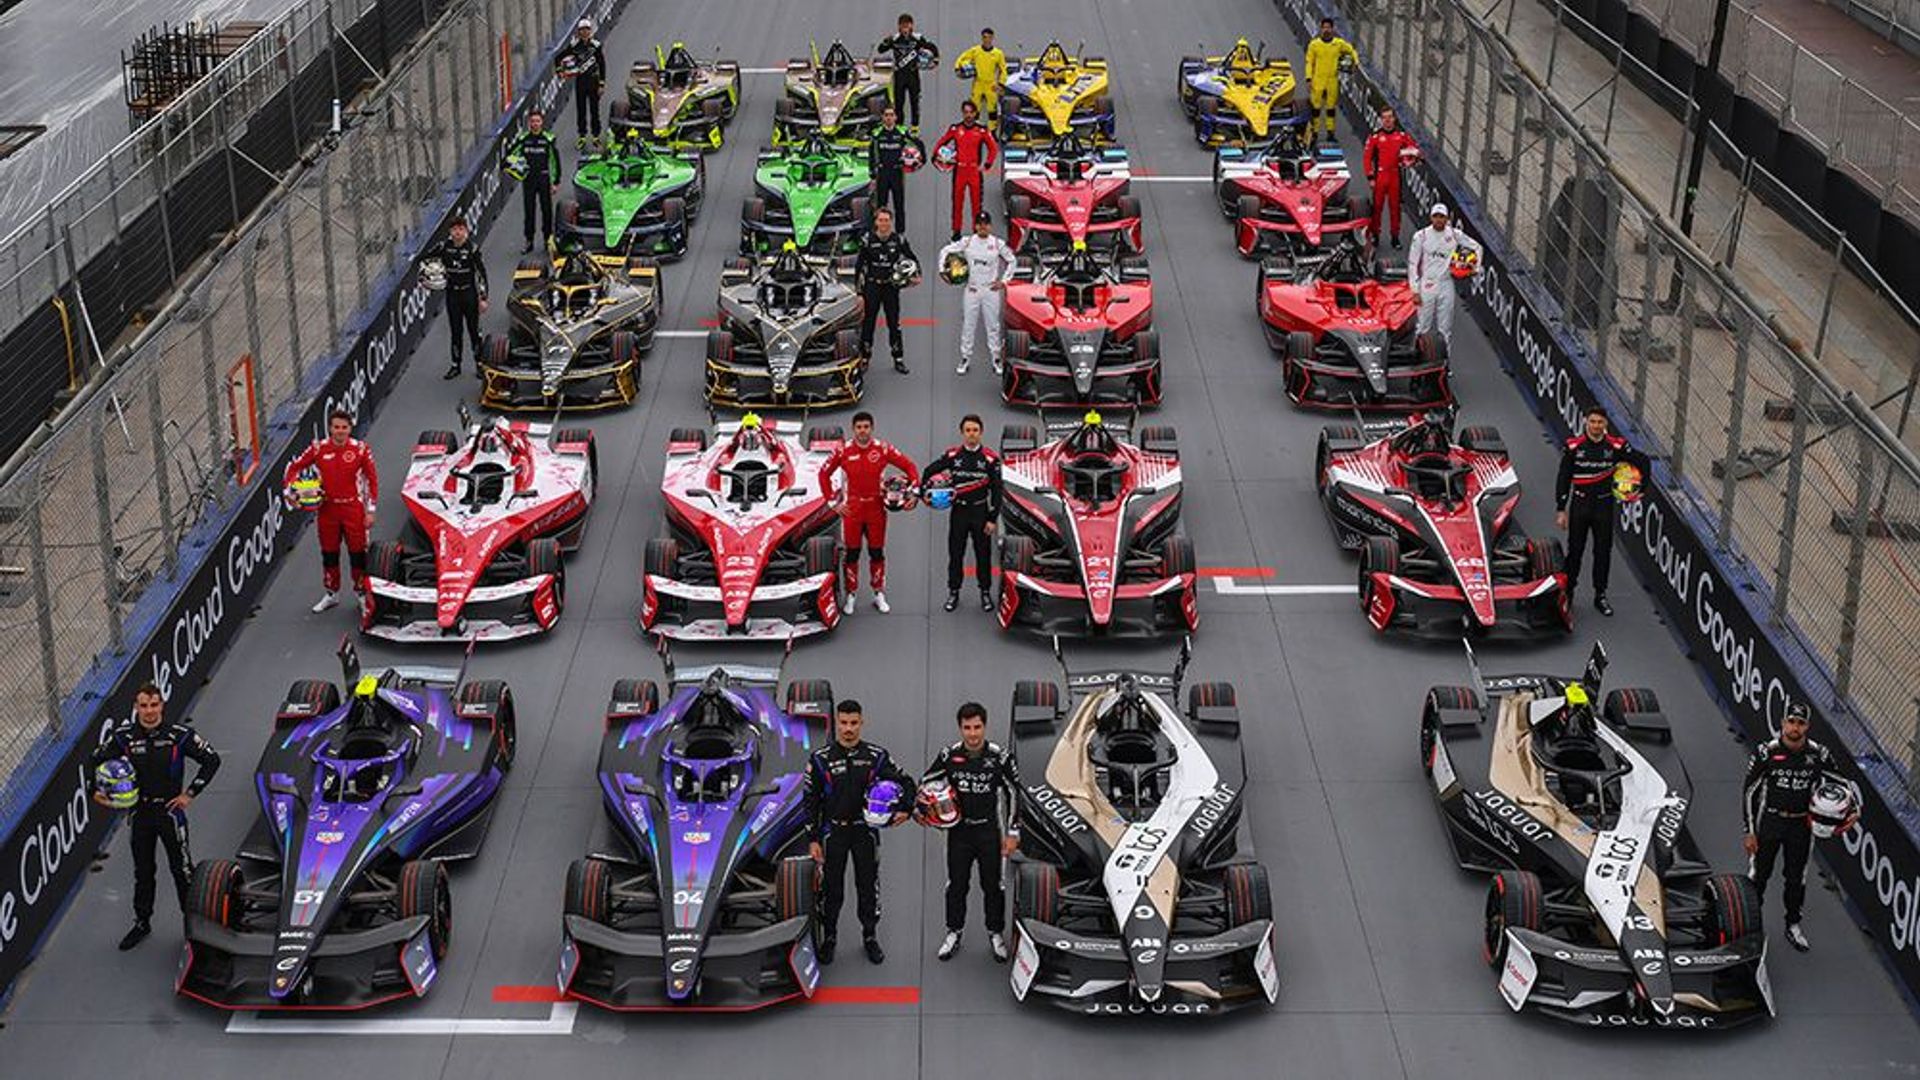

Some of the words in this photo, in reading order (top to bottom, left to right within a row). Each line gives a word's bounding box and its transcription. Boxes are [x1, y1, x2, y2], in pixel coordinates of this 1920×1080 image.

[1486, 266, 1514, 335] Cloud
[1516, 307, 1555, 398] Google
[1557, 369, 1586, 437] Clou
[173, 566, 224, 677] Cloud
[229, 488, 283, 594] Google
[1645, 503, 1691, 600] Cloud
[1697, 572, 1763, 712] Google
[21, 764, 89, 906] Cloud
[294, 889, 325, 904] 51
[674, 890, 703, 904] 04
[1623, 916, 1655, 930] 13
[1131, 938, 1162, 948] ABB
[1633, 949, 1664, 958] ABB
